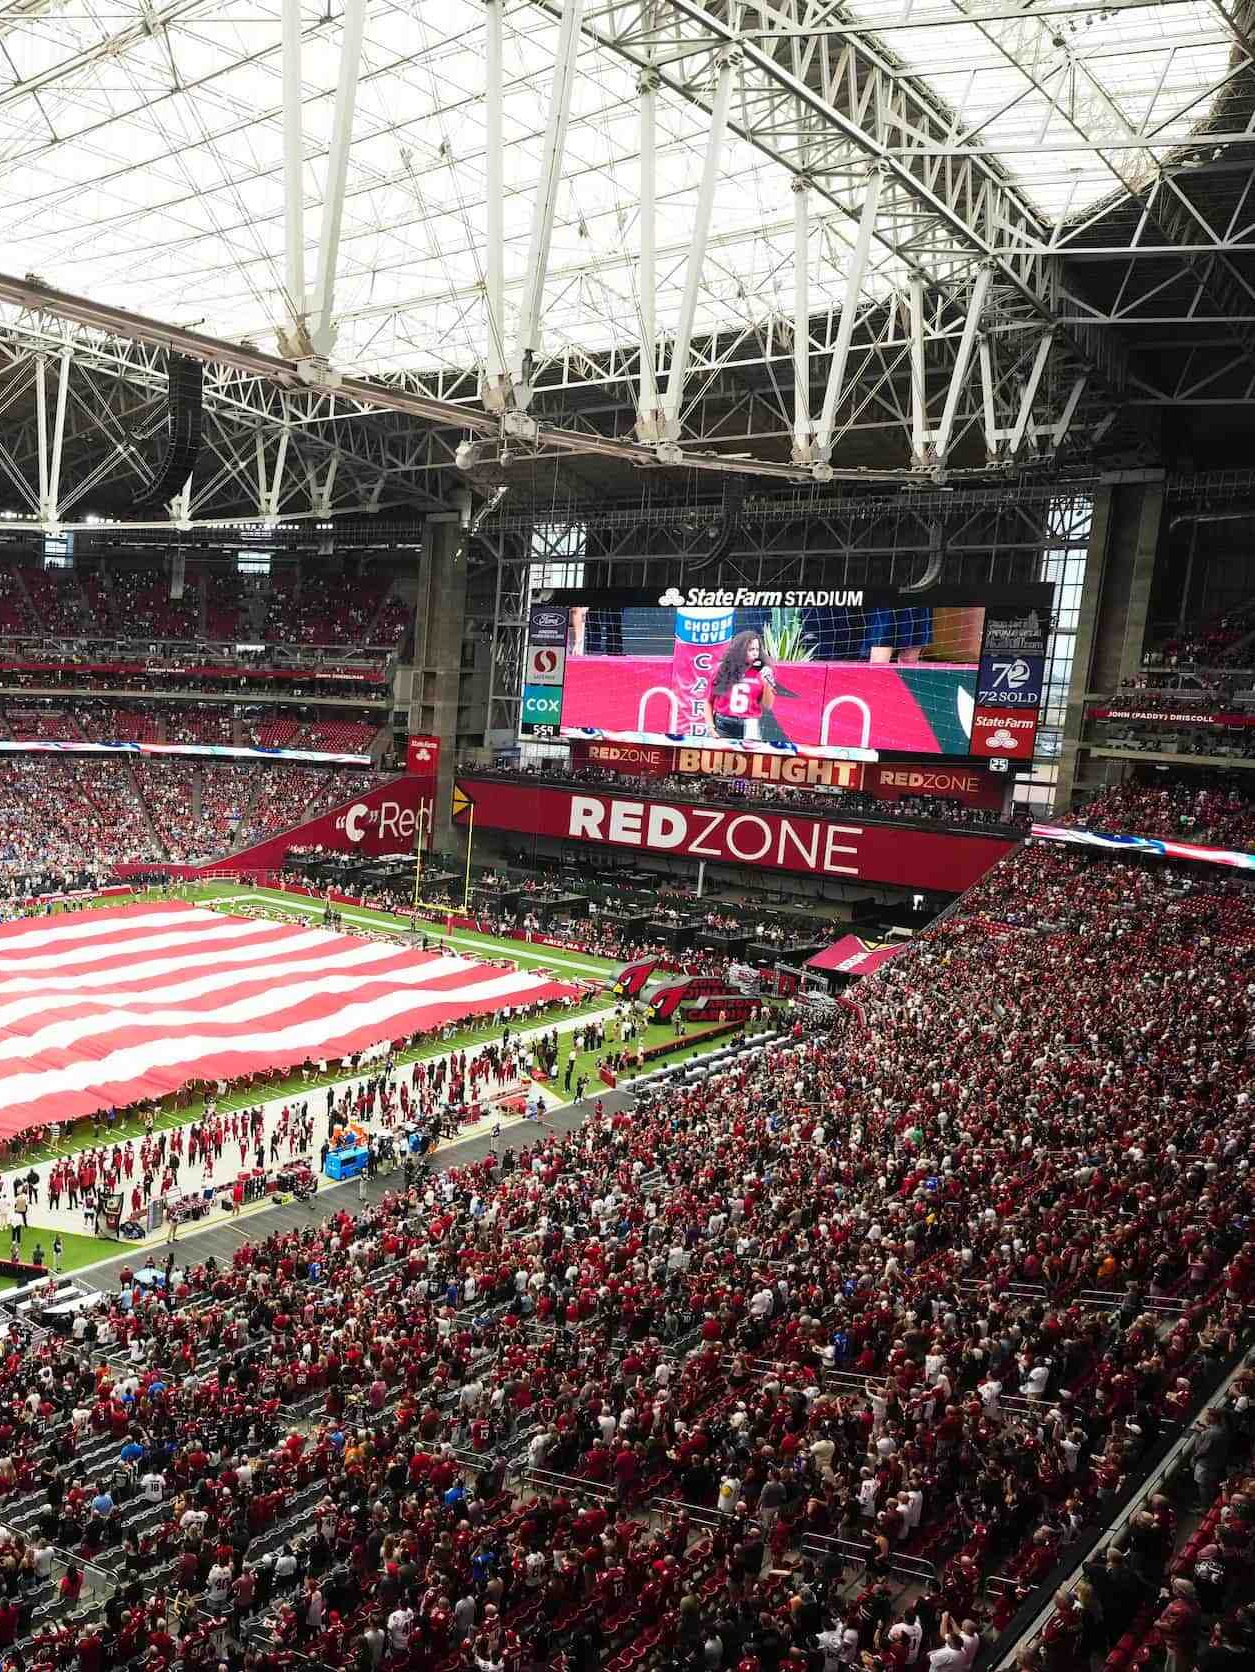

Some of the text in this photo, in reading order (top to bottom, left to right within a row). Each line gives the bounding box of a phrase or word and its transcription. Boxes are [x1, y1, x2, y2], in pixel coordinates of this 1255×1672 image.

[785, 591, 863, 606] STADIUM
[692, 630, 726, 643] LOVE
[992, 659, 1030, 688] 72
[526, 698, 559, 712] COX
[730, 682, 751, 713] 6
[1107, 711, 1130, 719] JOHN
[1170, 714, 1214, 722] DRISCOLL
[589, 747, 660, 764] REDZONE
[680, 749, 747, 776] BUD
[991, 759, 1007, 771] 25
[880, 770, 980, 793] REDZONE
[568, 796, 863, 875] REDZONE
